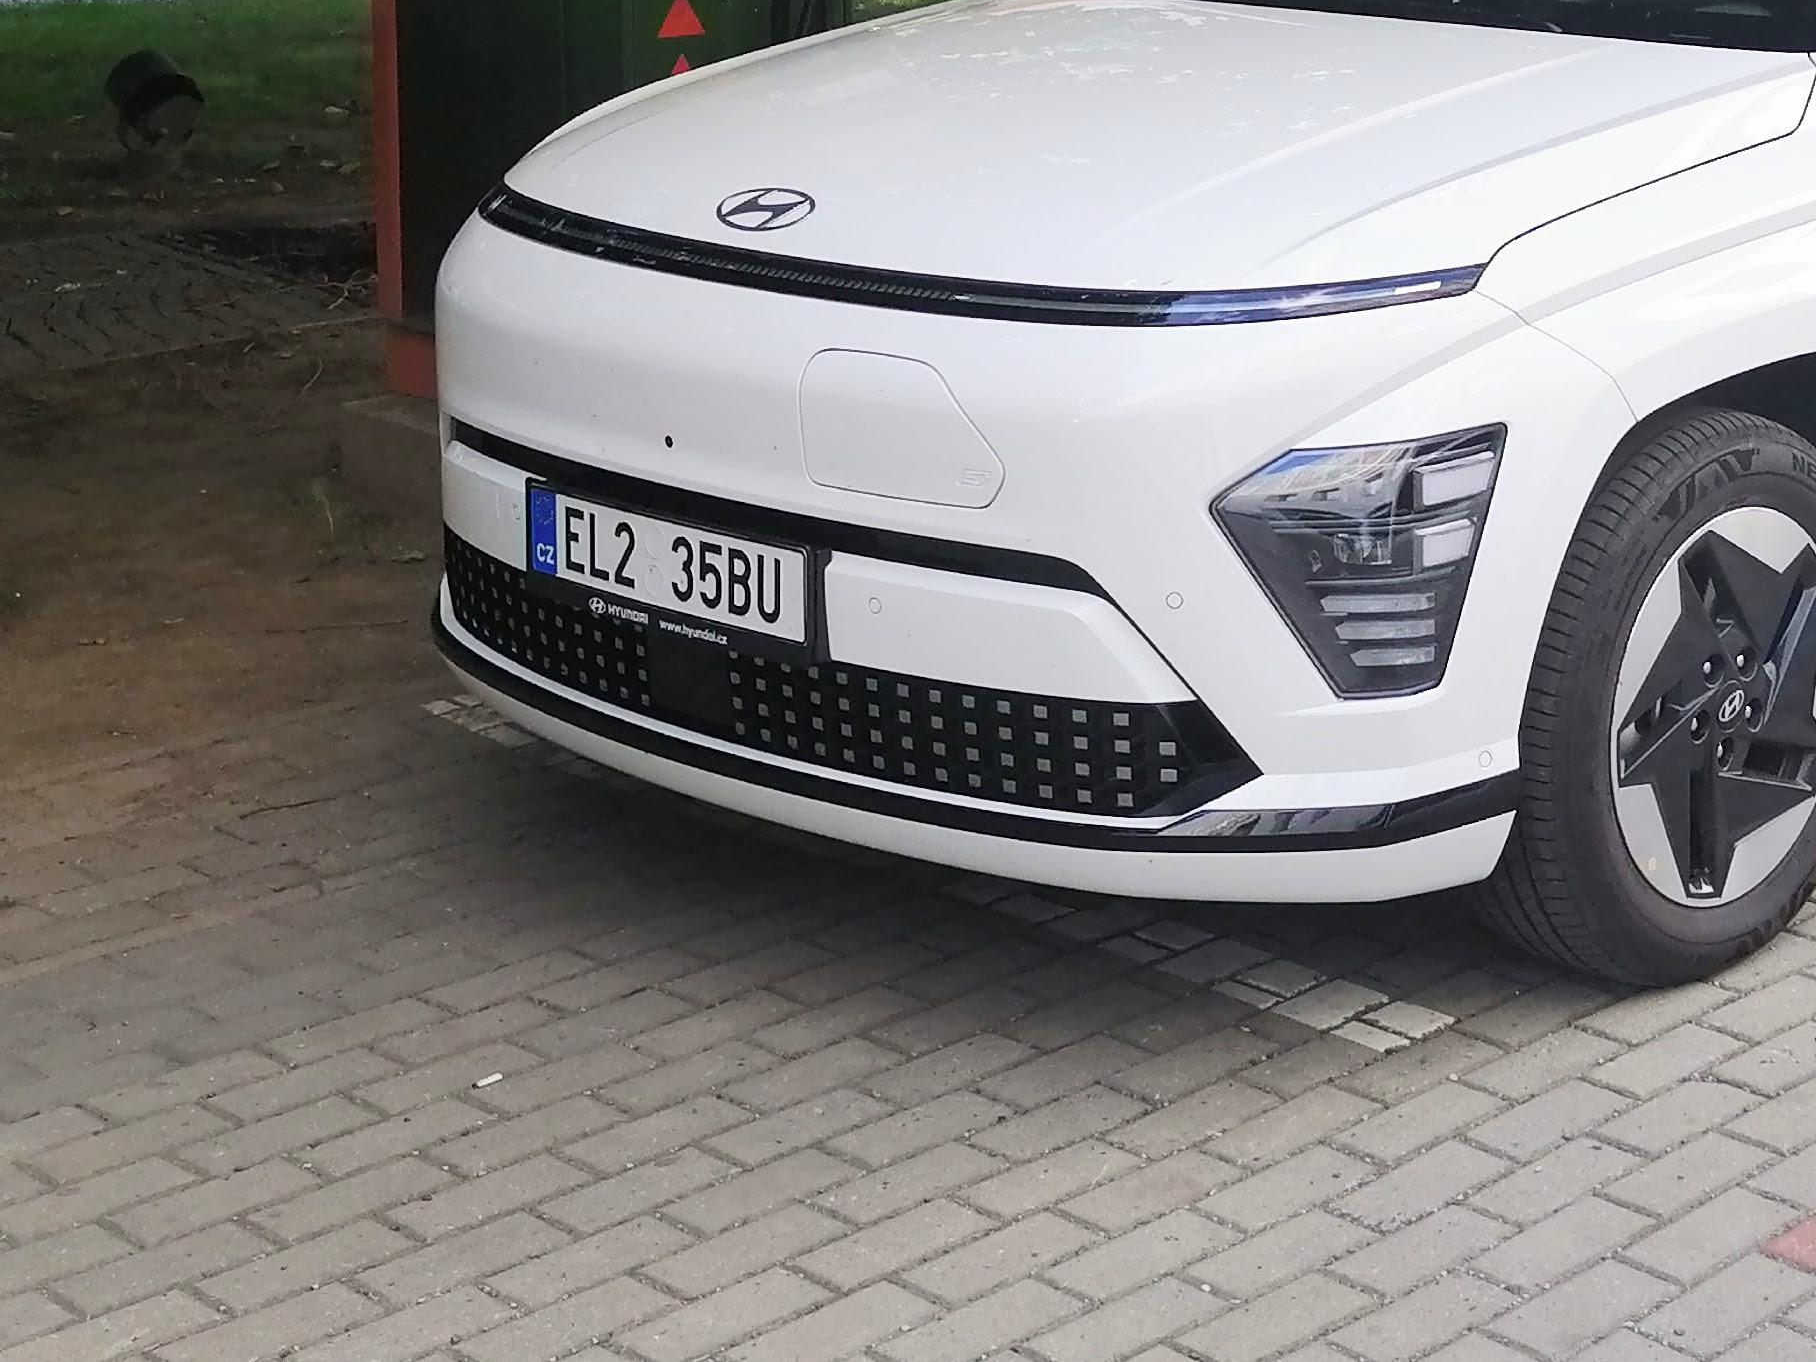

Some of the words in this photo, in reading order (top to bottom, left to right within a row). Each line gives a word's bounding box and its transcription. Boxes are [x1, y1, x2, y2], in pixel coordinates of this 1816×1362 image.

[536, 542, 555, 565] CZ
[564, 505, 635, 589] EL2
[671, 536, 781, 624] 35BU
[607, 603, 649, 625] HYUNDAI
[659, 619, 728, 646] www.hyundai.cz
